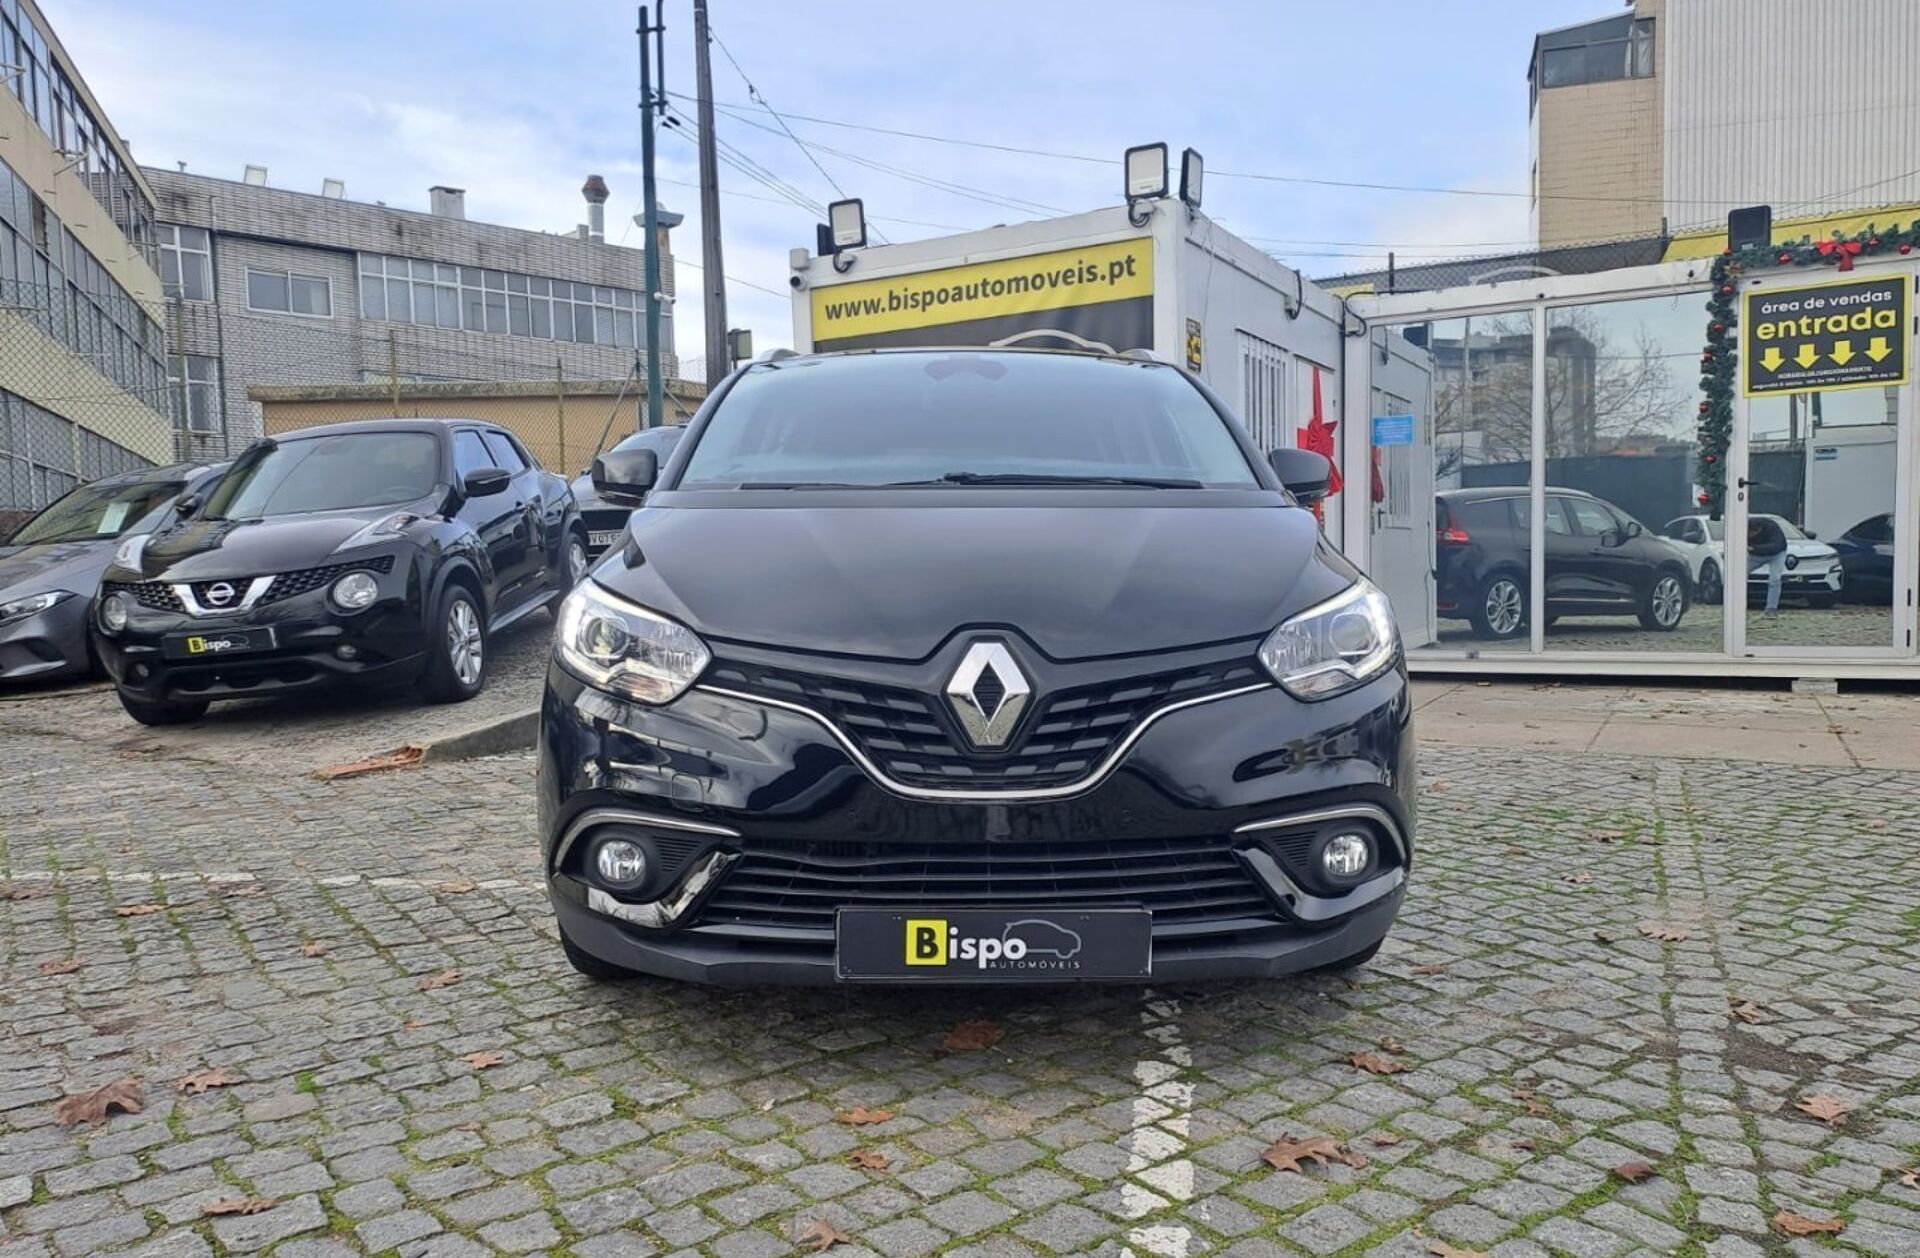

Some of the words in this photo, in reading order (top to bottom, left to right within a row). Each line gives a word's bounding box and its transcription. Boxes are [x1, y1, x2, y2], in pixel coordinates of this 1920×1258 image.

[825, 254, 1137, 321] www.bispoautomoveis.pt
[1761, 301, 1800, 314] área
[1804, 297, 1825, 309] de
[1829, 290, 1892, 306] vendas
[1756, 306, 1896, 340] entrada
[191, 639, 231, 652] Bispo
[916, 926, 1027, 969] Bispo
[989, 960, 1081, 970] AUTOMÓVEIS
